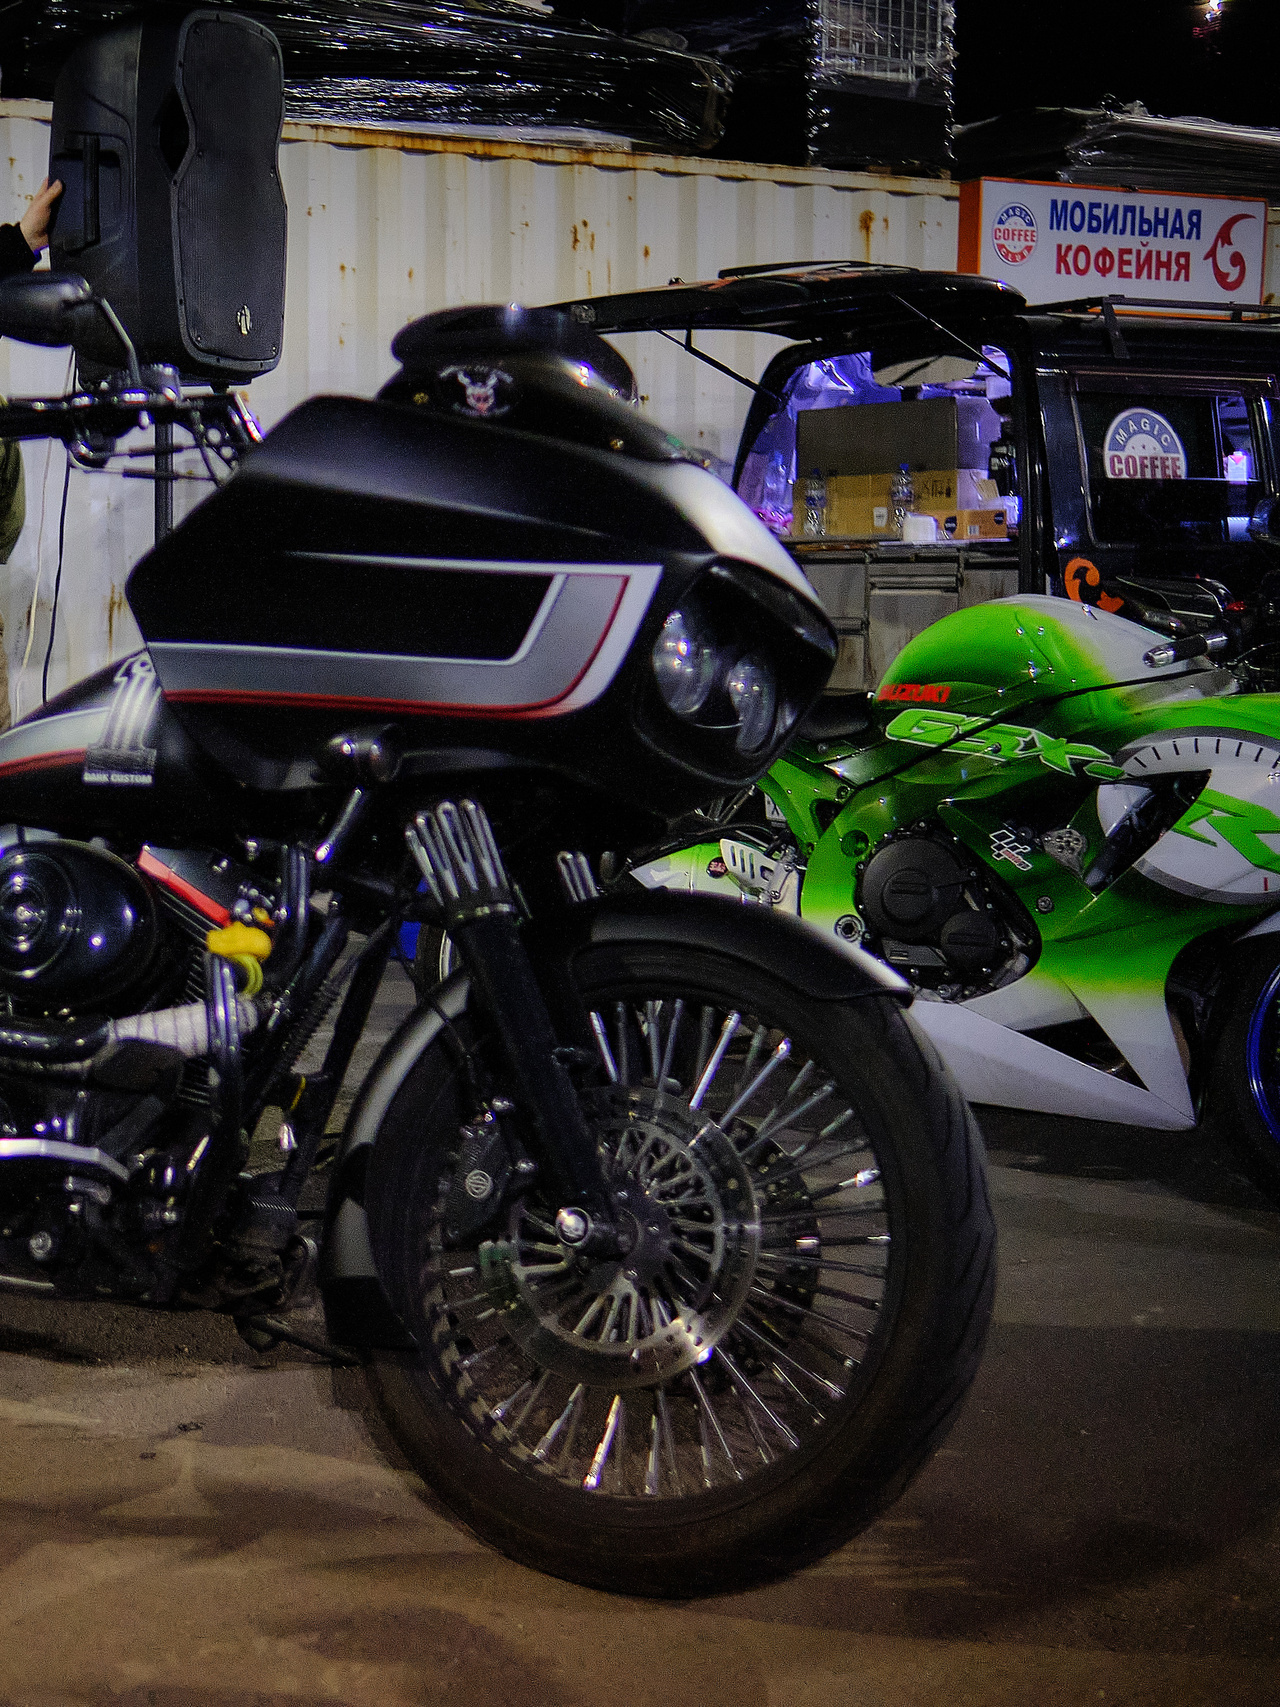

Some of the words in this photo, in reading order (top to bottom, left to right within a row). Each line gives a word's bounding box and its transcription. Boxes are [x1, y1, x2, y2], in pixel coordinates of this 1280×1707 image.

[1000, 207, 1031, 224] MAGIC
[1049, 199, 1202, 240] МОБИЛЬНАЯ
[994, 228, 1037, 243] COFFEE
[1055, 241, 1191, 282] КОФЕЙНЯ
[1115, 417, 1171, 446] MAGIC
[1110, 454, 1182, 479] COFFEE
[877, 684, 952, 703] SUZUKI
[110, 773, 153, 784] CUSTOM
